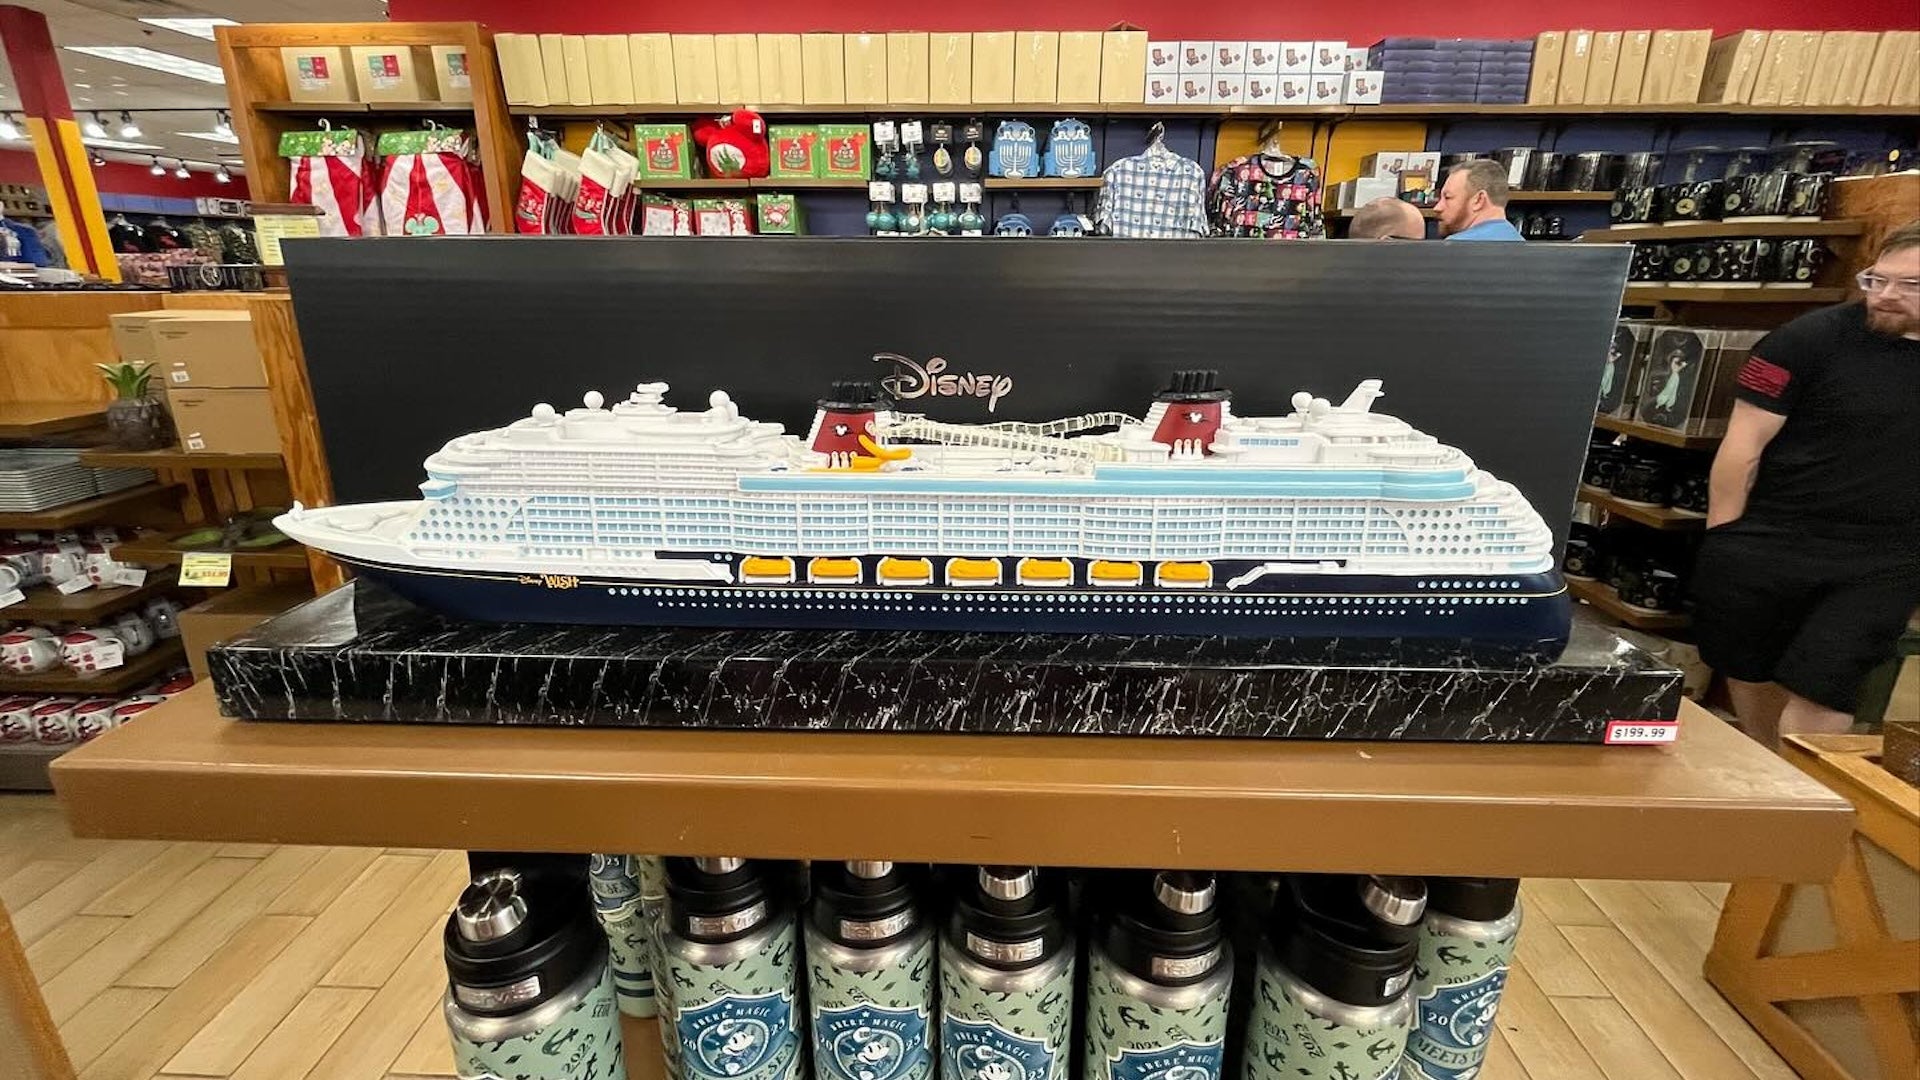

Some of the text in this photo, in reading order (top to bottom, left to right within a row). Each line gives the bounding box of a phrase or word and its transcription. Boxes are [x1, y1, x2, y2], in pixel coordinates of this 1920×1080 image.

[872, 352, 1013, 413] Disney
[541, 574, 579, 588] WISH
[1614, 728, 1665, 738] $199.99
[735, 1006, 771, 1017] MAGIC
[872, 1019, 907, 1031] MAGIC
[1427, 1012, 1449, 1026] 20
[995, 1039, 1031, 1060] MAGIC
[1417, 1036, 1468, 1065] MEETS
